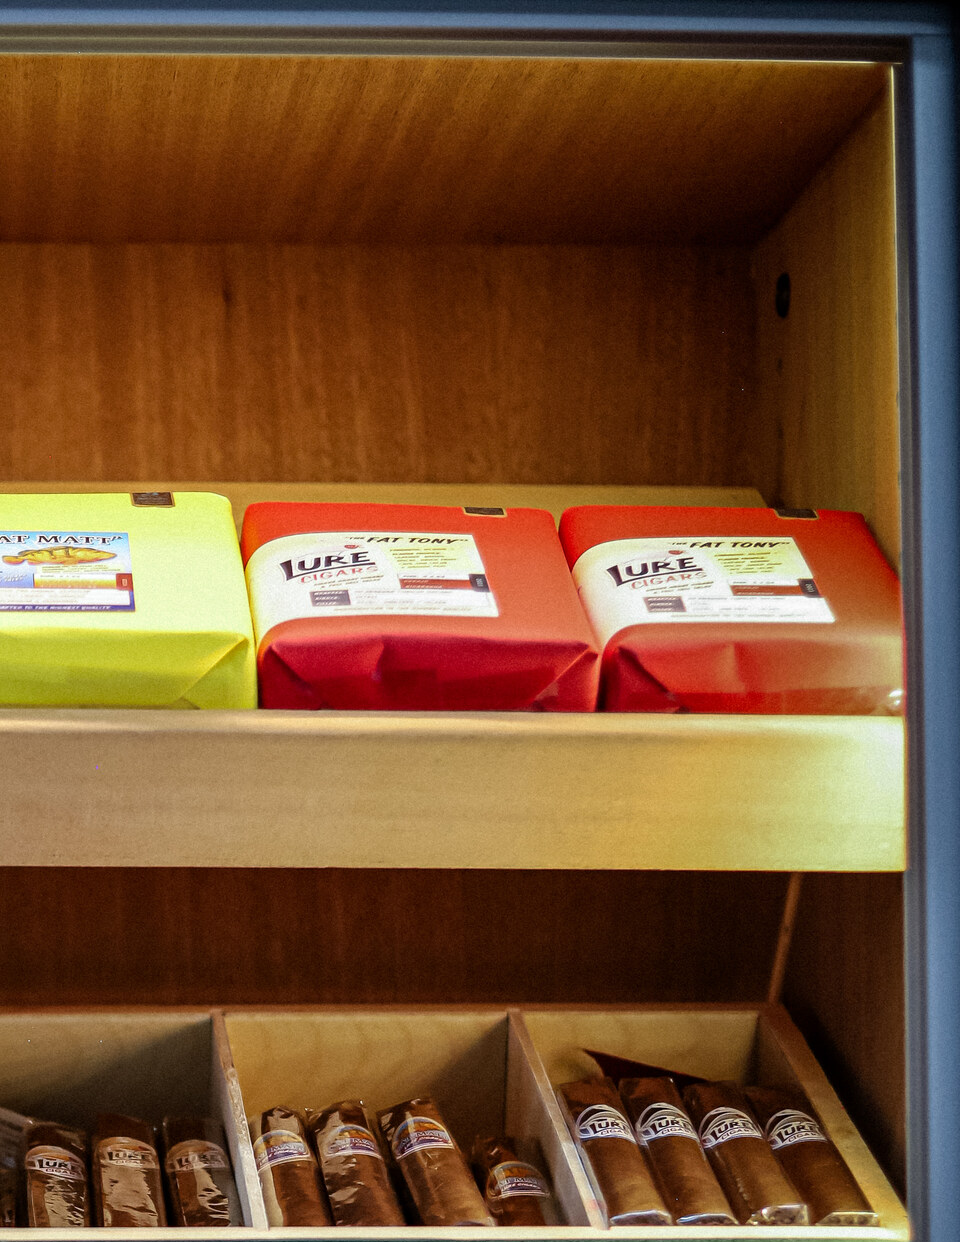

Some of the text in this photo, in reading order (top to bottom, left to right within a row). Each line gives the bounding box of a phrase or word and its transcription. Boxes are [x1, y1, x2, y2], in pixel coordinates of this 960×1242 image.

[36, 535, 123, 545] MATT"
[280, 551, 376, 582] LURE
[300, 565, 379, 583] CIGARS
[607, 556, 703, 587] LURE
[631, 572, 707, 590] CIGARS
